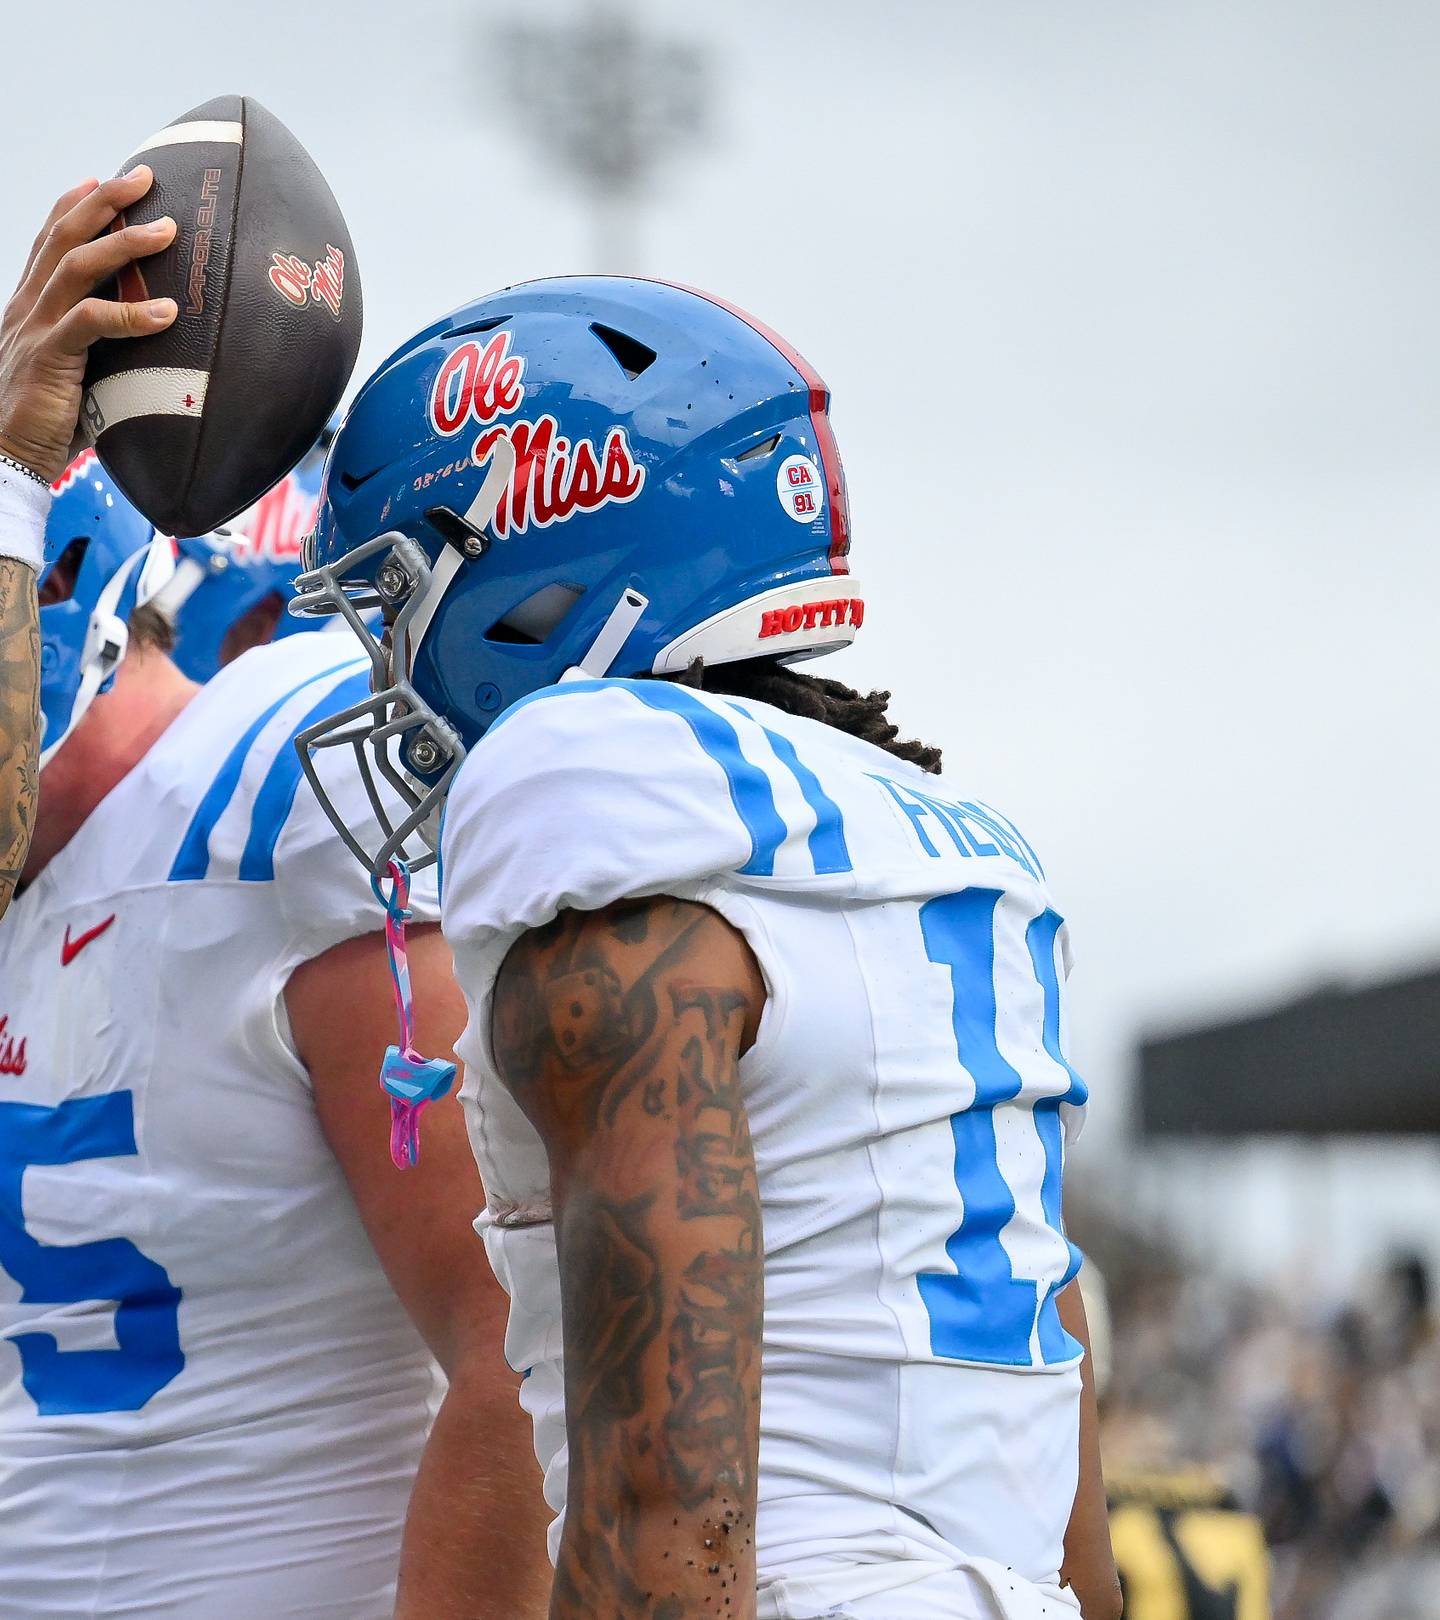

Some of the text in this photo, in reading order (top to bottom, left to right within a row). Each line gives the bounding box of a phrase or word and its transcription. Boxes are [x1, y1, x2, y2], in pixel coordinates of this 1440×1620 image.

[176, 168, 222, 314] VAPOR ELITE
[269, 243, 344, 316] Ole Miss
[429, 332, 527, 437] Ole
[473, 413, 647, 540] Miss
[786, 464, 813, 486] CA
[793, 493, 816, 514] 91
[757, 598, 850, 639] HOTTY
